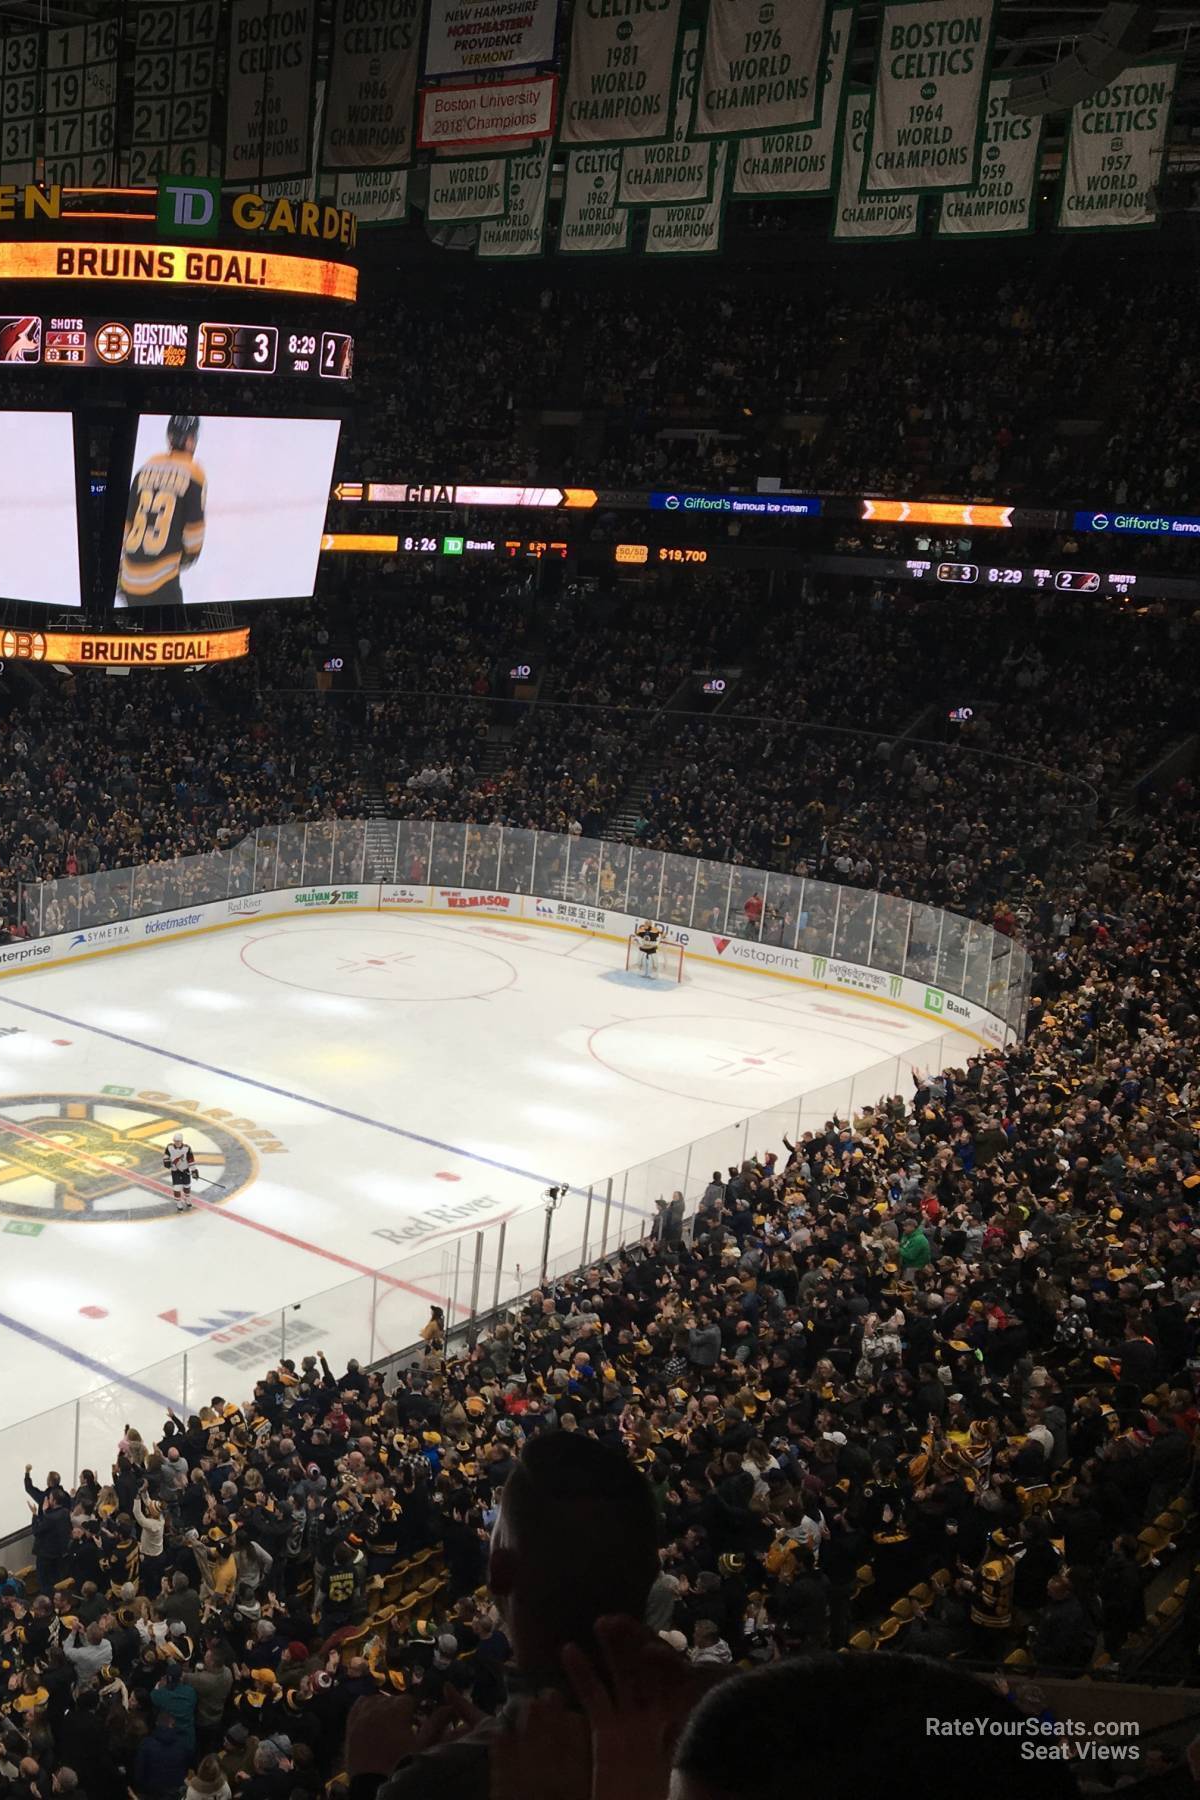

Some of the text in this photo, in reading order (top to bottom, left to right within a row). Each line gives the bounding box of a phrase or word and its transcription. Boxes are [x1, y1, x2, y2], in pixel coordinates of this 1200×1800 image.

[343, 0, 416, 24] BOSTON
[445, 1, 538, 22] NEW HAMPSHIRE
[139, 11, 174, 47] 22
[183, 5, 213, 41] 14
[239, 8, 307, 44] BOSTON
[447, 16, 533, 38] NORTHEASTERN
[92, 24, 115, 57] 16
[344, 23, 412, 54] CELTICS
[454, 33, 522, 50] PROVIDENCE
[745, 29, 781, 53] 1976
[890, 17, 982, 50] BOSTON
[8, 39, 36, 71] 33
[58, 33, 68, 64] 1
[239, 41, 302, 74] CELTICS
[462, 50, 514, 65] VERMONT
[607, 45, 638, 68] 1981
[180, 51, 210, 87] 15
[729, 53, 791, 82] WORLD
[891, 47, 975, 80] CELTICS
[137, 57, 170, 92] 23
[591, 71, 647, 94] WORLD
[6, 80, 34, 114] 35
[51, 75, 78, 107] 19
[359, 81, 387, 100] 1986
[705, 77, 808, 110] CHAMPIONS
[1082, 82, 1165, 110] BOSTON
[435, 90, 540, 112] Boston University
[570, 94, 661, 121] CHAMPIONS
[135, 105, 166, 138] 21
[175, 98, 208, 136] 25
[348, 105, 393, 124] WORLD
[434, 113, 537, 134] 2018 Champions
[909, 104, 943, 124] 1964
[1082, 109, 1158, 134] CELTICS
[48, 119, 78, 152] 17
[88, 112, 113, 147] 18
[248, 119, 288, 137] WORLD
[330, 127, 406, 145] CHAMPIONS
[897, 127, 953, 146] WORLD
[7, 124, 31, 156] 31
[233, 138, 298, 161] CHAMPIONS
[762, 135, 813, 153] WORLD
[181, 148, 195, 176] 6
[644, 146, 691, 164] WORLD
[743, 155, 826, 175] CHAMPIONS
[875, 146, 968, 170] CHAMPIONS
[1101, 155, 1132, 172] 1957
[132, 151, 162, 183] 24
[449, 166, 490, 184] WORLD
[626, 166, 704, 185] CHAMPIONS
[268, 182, 300, 196] WORLD
[355, 173, 392, 187] WORLD
[1087, 174, 1137, 191] WORLD
[341, 188, 402, 206] CHAMPIONS
[433, 183, 501, 203] CHAMPIONS
[587, 192, 609, 204] 1962
[166, 186, 357, 249] TD GARDEN
[579, 208, 615, 221] WORLD
[666, 209, 704, 221] WORLD
[842, 204, 912, 222] CHAMPIONS
[946, 198, 1026, 218] CHAMPIONS
[483, 229, 540, 244] CHAMPIONS
[652, 223, 714, 238] CHAMPIONS
[56, 247, 267, 284] BRUINS GOAL!
[51, 318, 83, 330] SHOTS
[67, 335, 80, 344] 16
[254, 333, 269, 362] 3
[288, 335, 315, 354] 8:29
[66, 351, 79, 360] 18
[134, 345, 164, 365] TEAM
[165, 355, 186, 365] 1924
[326, 340, 336, 367] 2
[294, 360, 309, 371] 2ND
[684, 497, 808, 513] Gifford's famous ice cream
[1114, 516, 1169, 530] Gifford's
[404, 538, 437, 551] 8:26
[446, 540, 495, 551] TD Bank
[619, 548, 644, 556] 50/50
[659, 549, 707, 562] $19,700
[906, 560, 931, 570] SHOTS
[961, 566, 971, 580] 3
[988, 568, 1022, 583] 8:29
[1033, 569, 1052, 578] PER.
[1038, 578, 1044, 586] 2
[1061, 573, 1071, 587] 2
[1108, 574, 1136, 584] SHOTS
[1115, 584, 1128, 592] 16
[81, 641, 210, 661] BRUINS GOAL!
[331, 658, 343, 668] 10
[517, 665, 531, 676] 10
[711, 679, 726, 691] 10
[294, 888, 359, 903] SULLIVAN TIRE
[227, 899, 263, 913] Red River
[145, 913, 202, 934] ticketmaster
[87, 926, 130, 943] SYMETRA
[732, 945, 800, 969] vistaprint
[829, 963, 887, 988] MONSTER
[837, 976, 878, 991] ENERGY
[947, 999, 971, 1018] Bank
[136, 1090, 289, 1154] GARDEN
[371, 1194, 502, 1245] Red River
[329, 1580, 353, 1601] 63
